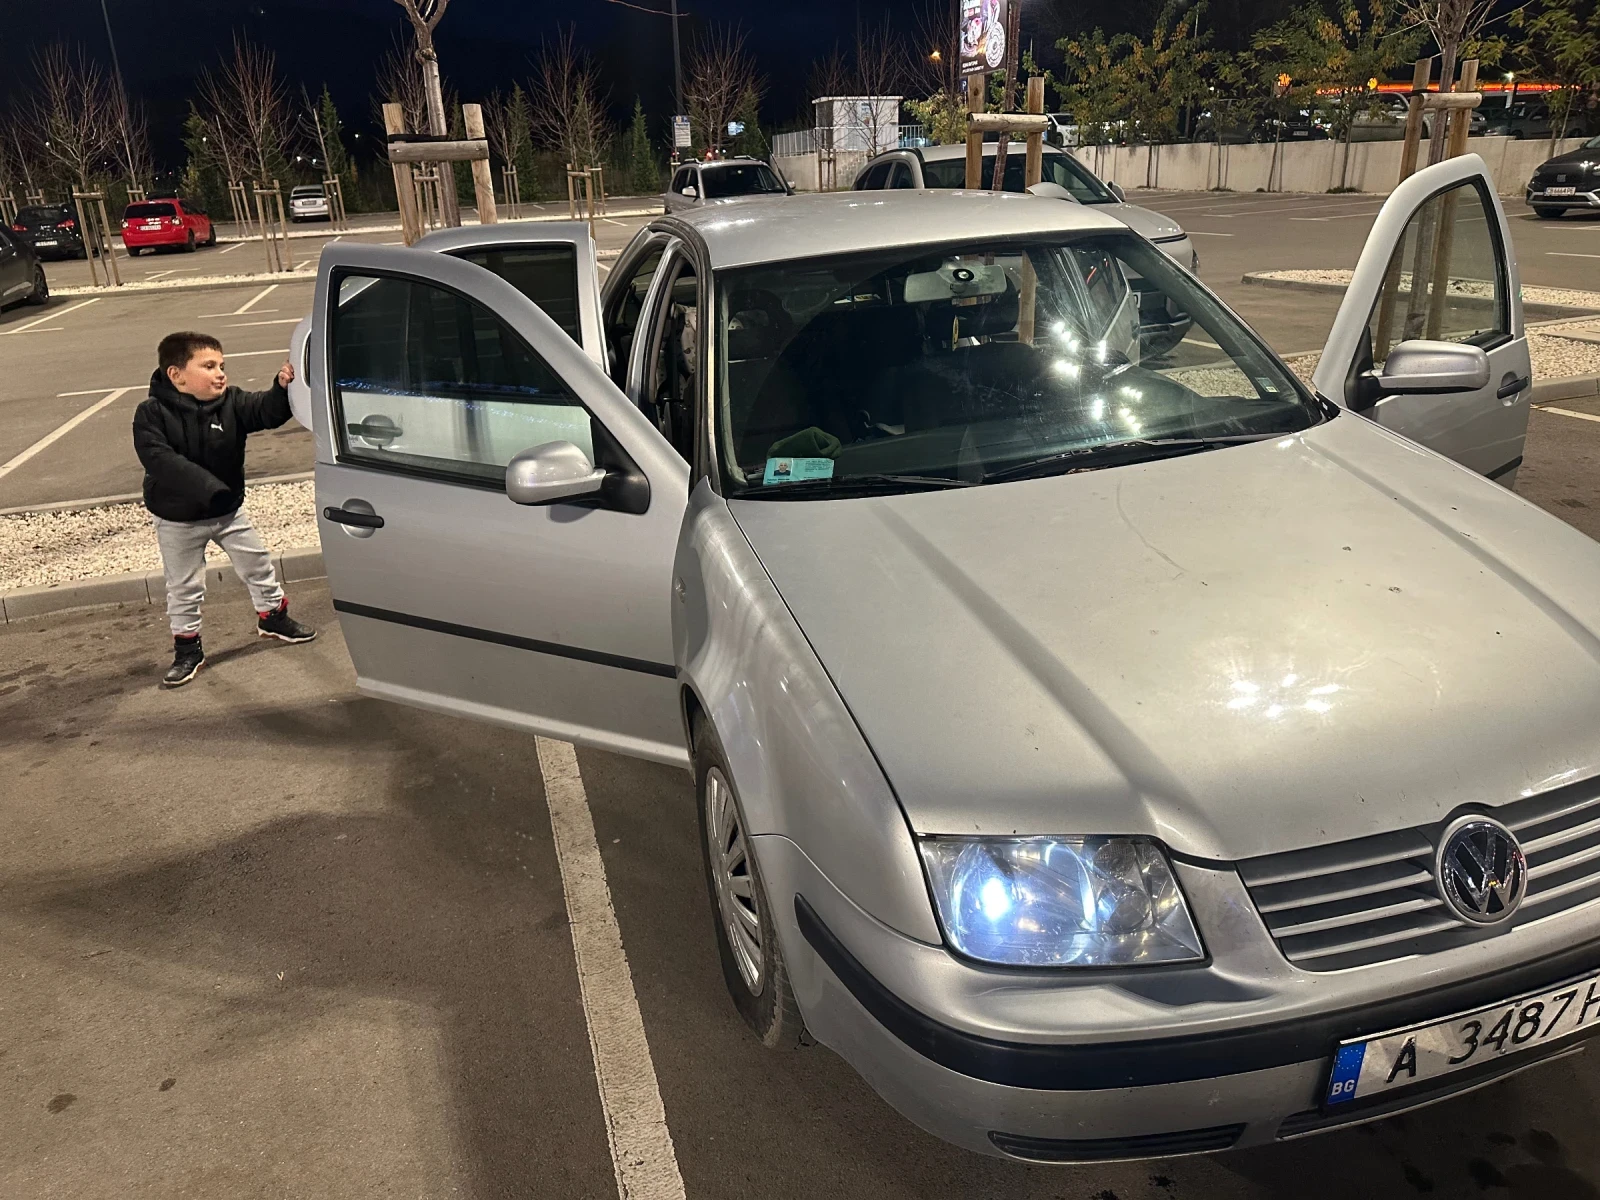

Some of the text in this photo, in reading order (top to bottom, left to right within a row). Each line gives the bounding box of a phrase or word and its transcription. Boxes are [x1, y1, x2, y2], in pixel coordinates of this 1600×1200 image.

[1442, 820, 1524, 920] VW
[1385, 1034, 1417, 1084] A
[1446, 988, 1579, 1065] 3487
[1331, 1079, 1355, 1096] BG
